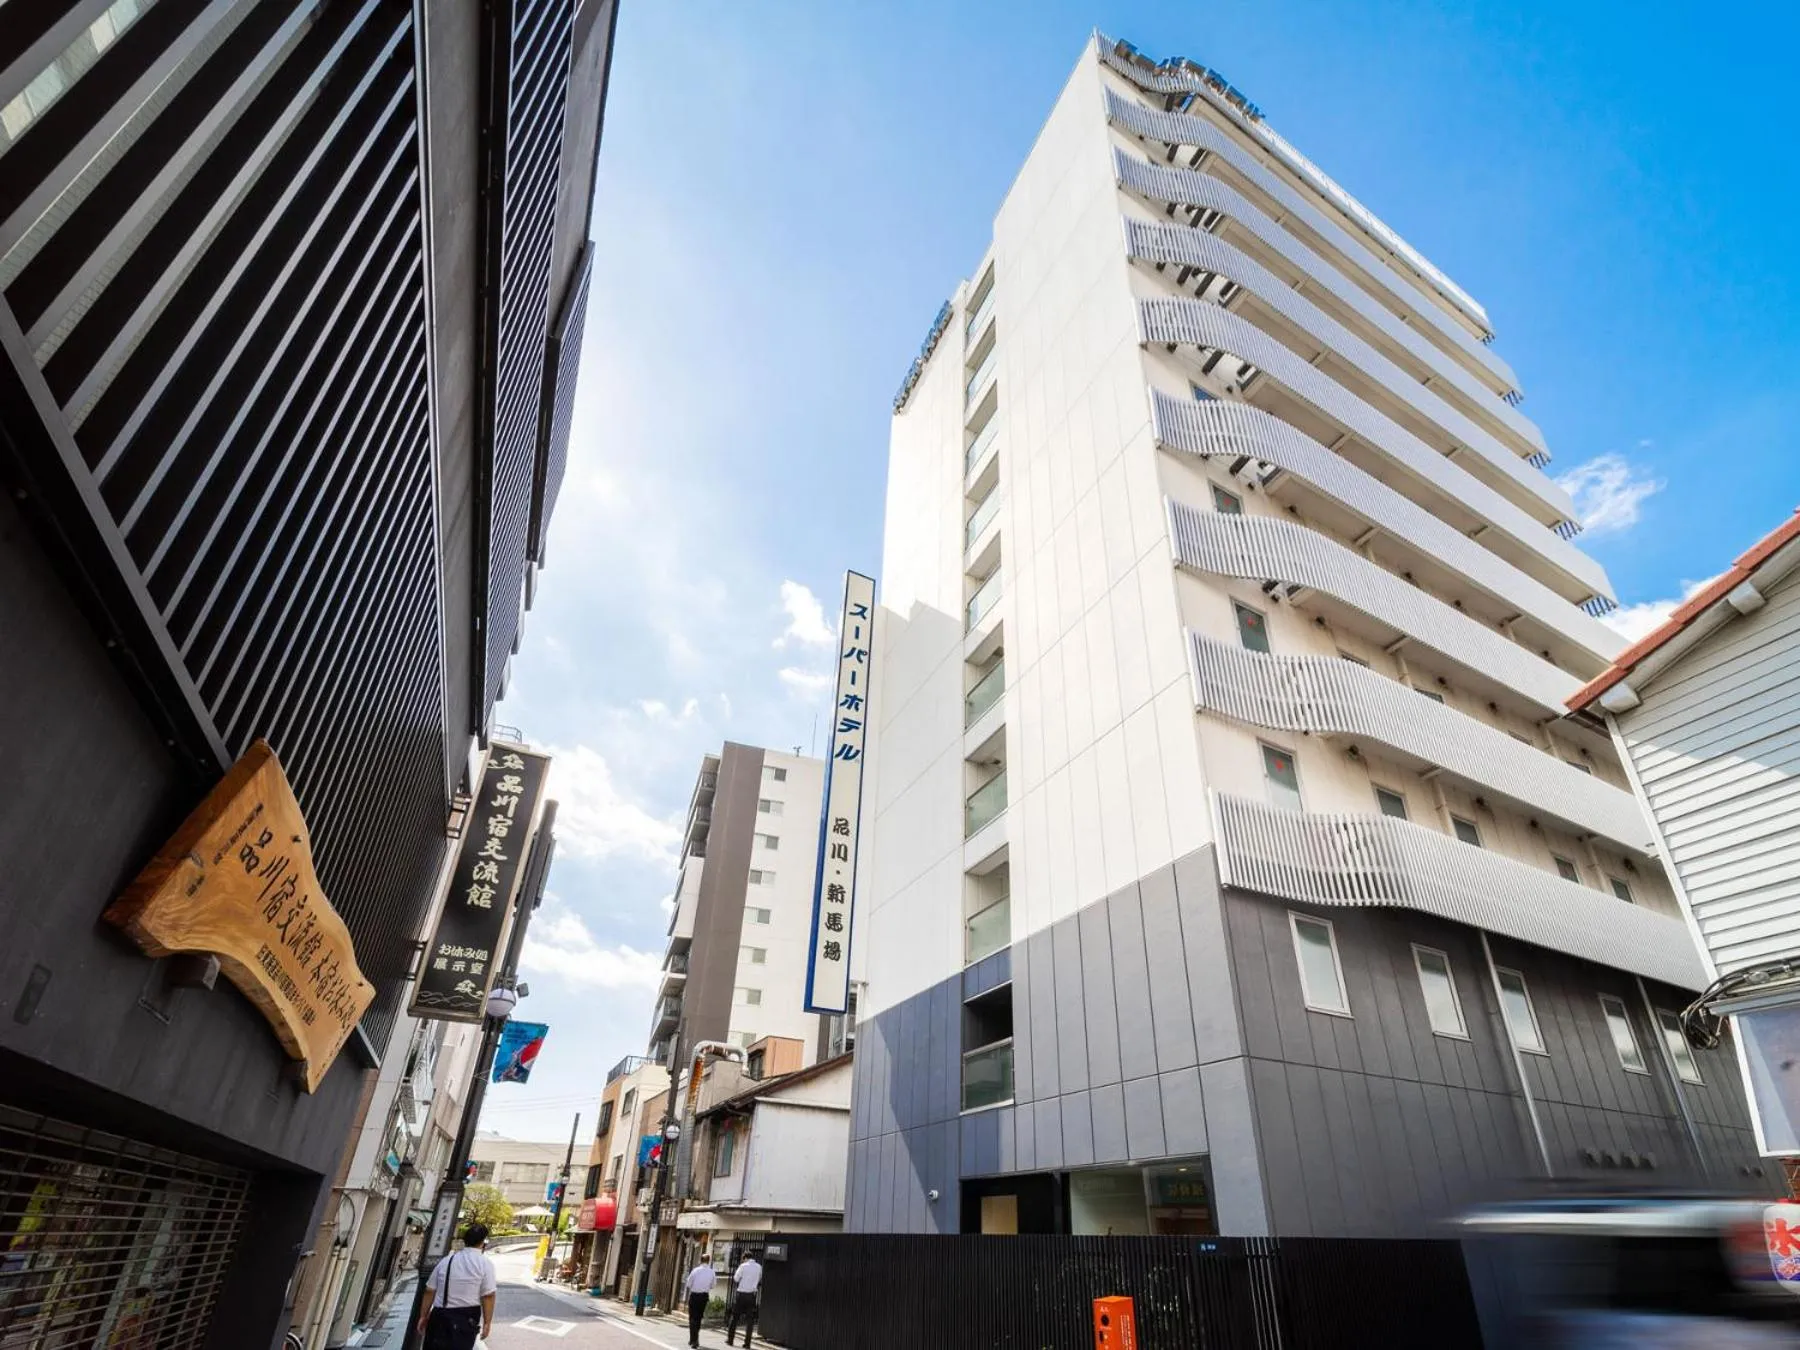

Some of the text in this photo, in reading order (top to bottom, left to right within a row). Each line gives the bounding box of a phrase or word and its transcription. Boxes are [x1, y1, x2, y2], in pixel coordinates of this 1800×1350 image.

[834, 603, 868, 761] スーパーホテル
[239, 826, 324, 969] 品川宿交流館
[466, 775, 524, 909] 品川宿交流館
[823, 817, 850, 962] 品川・新馬場
[433, 957, 486, 975] 展示室
[439, 943, 489, 961] お休み処
